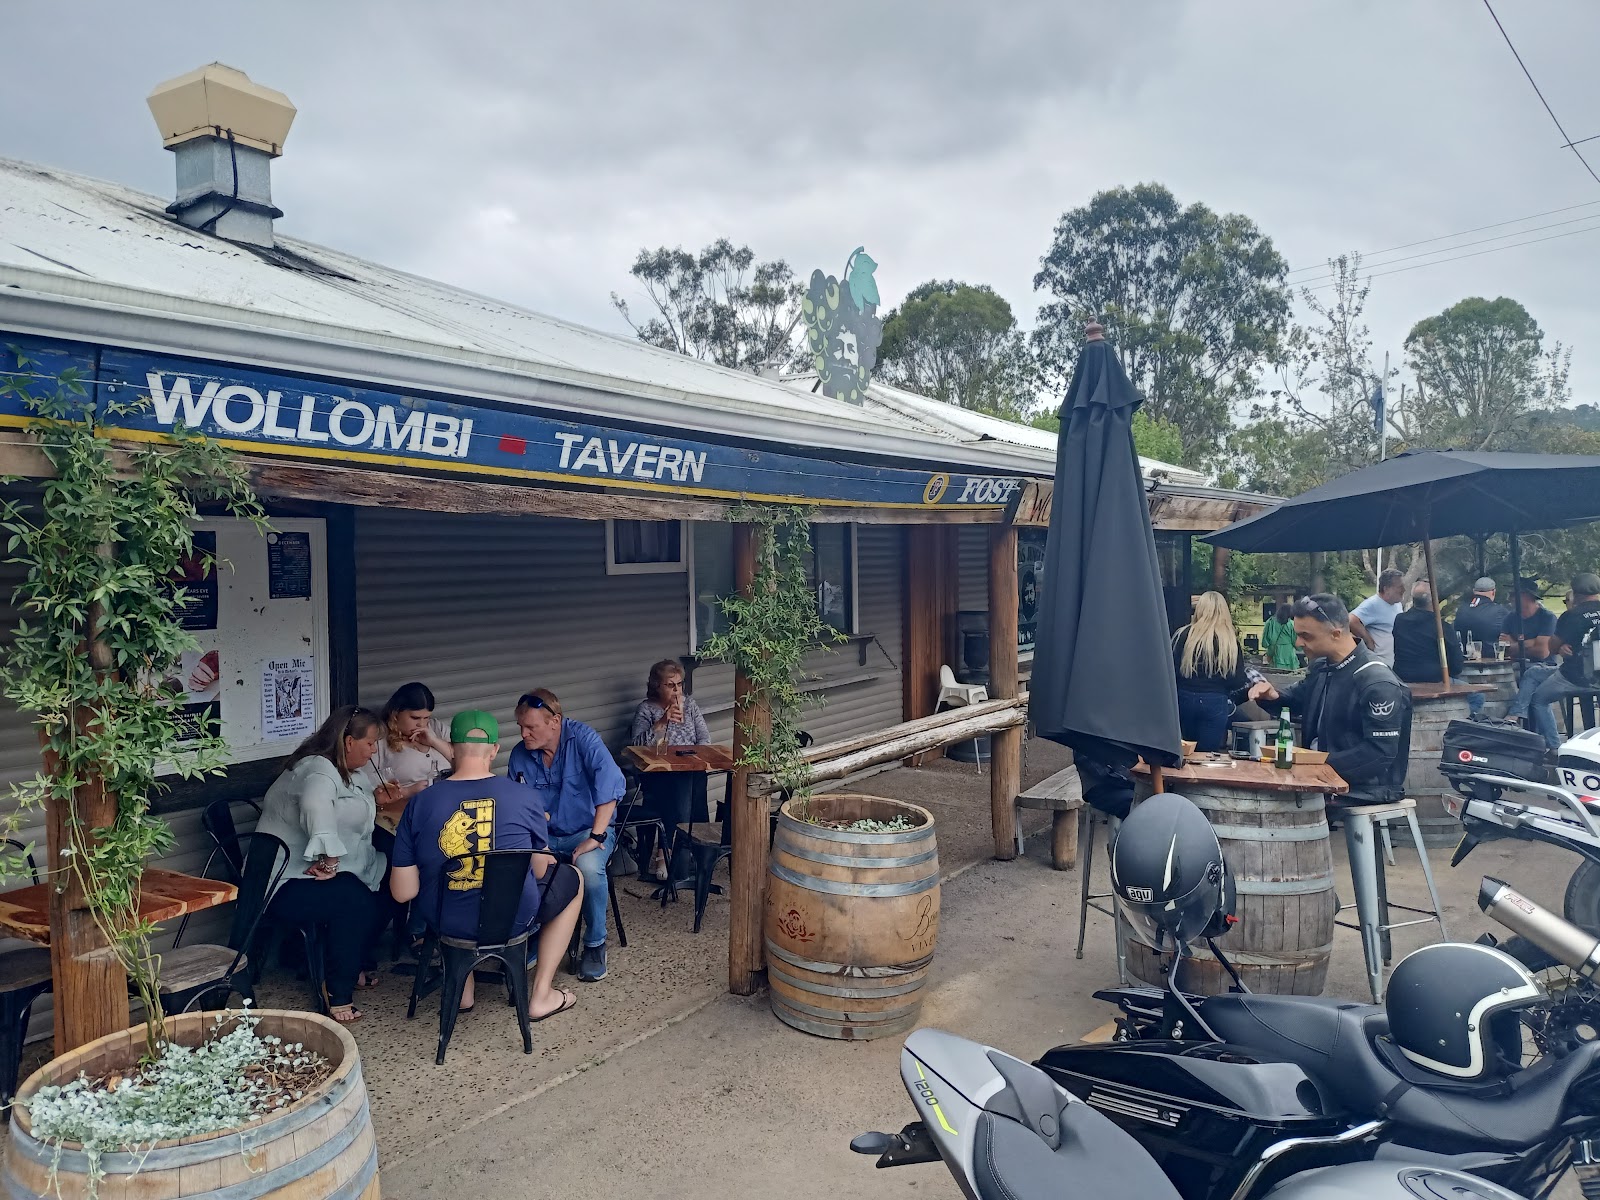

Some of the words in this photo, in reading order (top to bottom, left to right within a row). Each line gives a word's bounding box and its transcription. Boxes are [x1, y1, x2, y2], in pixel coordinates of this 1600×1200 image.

[146, 372, 474, 459] WOLLOMBI
[554, 431, 707, 483] TAVERN
[268, 661, 288, 672] Open
[913, 1079, 939, 1106] 1200
